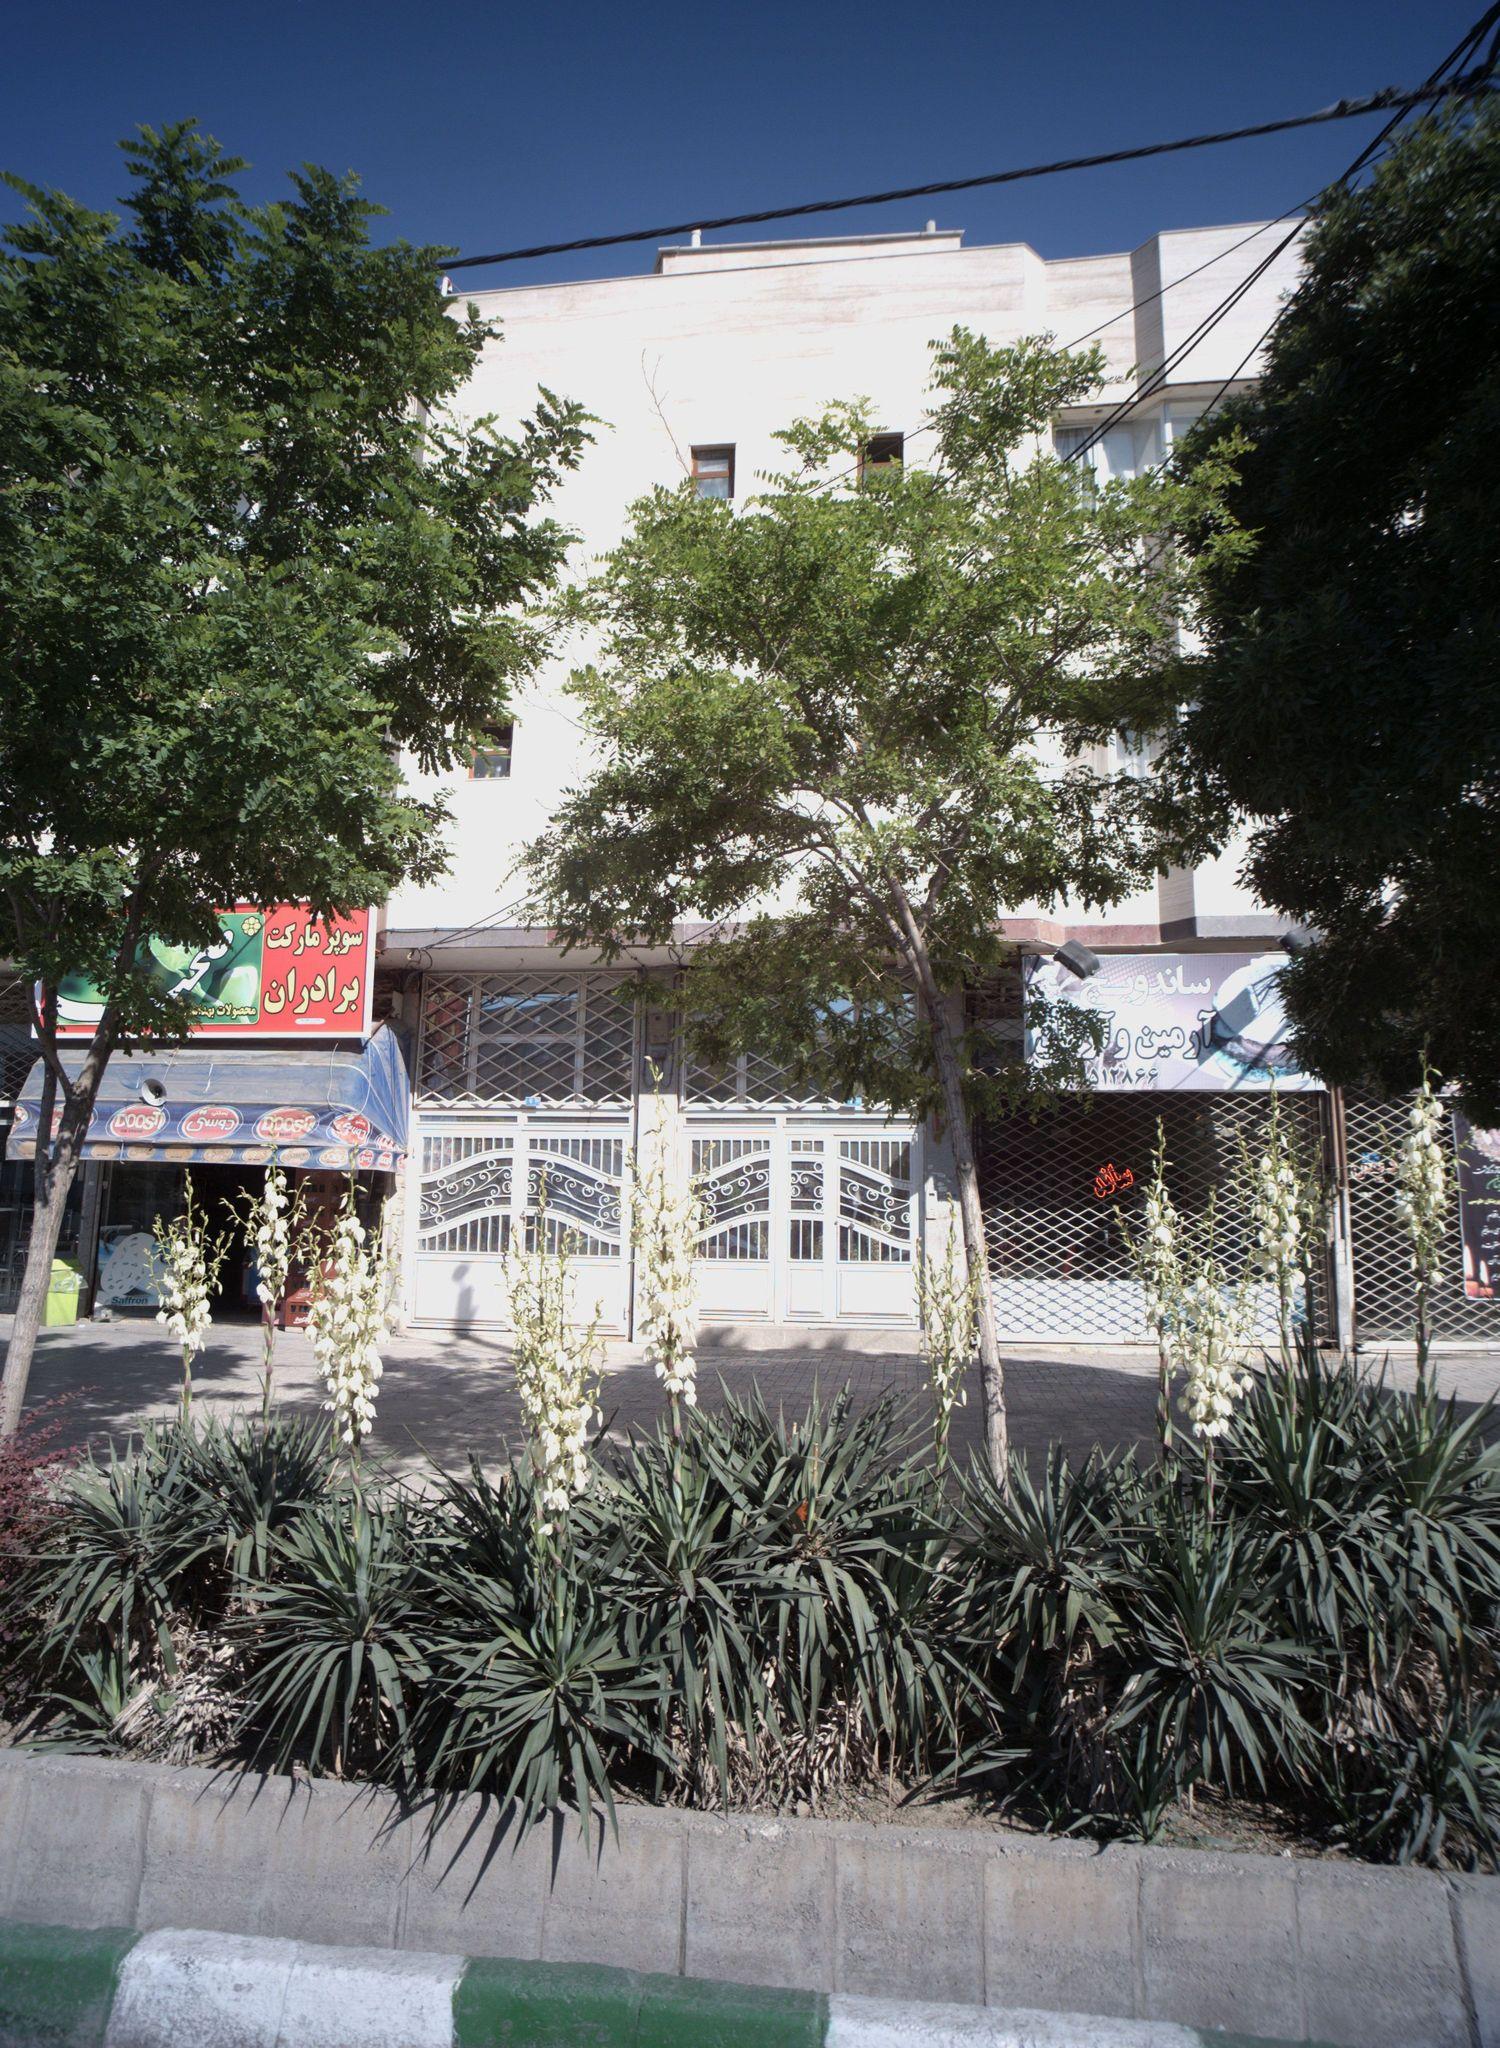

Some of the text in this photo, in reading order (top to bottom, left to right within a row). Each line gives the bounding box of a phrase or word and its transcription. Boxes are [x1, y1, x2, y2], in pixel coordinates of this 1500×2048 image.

[266, 922, 363, 956] سوپر مارکت
[263, 965, 360, 1014] برادران
[1080, 965, 1212, 1007] ساندویچ
[216, 1002, 257, 1019] محصولات
[1113, 1028, 1131, 1060] و
[1135, 1010, 1217, 1059] آرمین
[111, 1296, 148, 1305] Saffron
